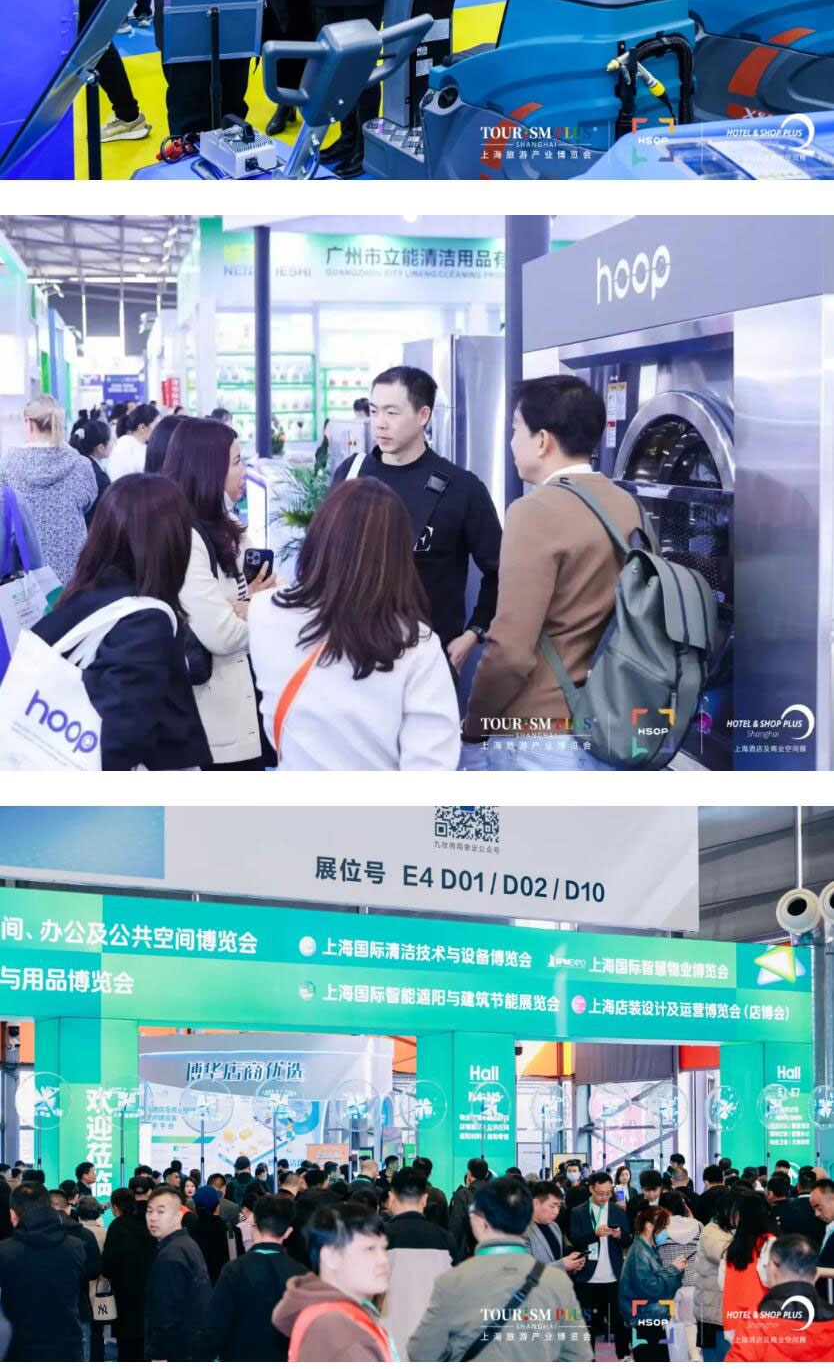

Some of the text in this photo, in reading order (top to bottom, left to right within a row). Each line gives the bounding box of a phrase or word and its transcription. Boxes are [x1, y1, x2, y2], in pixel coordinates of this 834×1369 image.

[325, 246, 505, 269] 广州市立能清洁用品有
[596, 245, 671, 305] hoop
[25, 689, 98, 754] hoop
[315, 855, 606, 903] 展位号 E4 D01 / D02 / D10
[1, 916, 259, 954] 间、办公及公共空间博览会
[322, 937, 532, 969] 上海国际清洁技术与设备博览会
[0, 967, 135, 995] 与用品博览会
[589, 956, 730, 980] 上海国际智慧物业博览会
[322, 983, 561, 1012] 上海国际智能遮阳与建筑节能展览会
[186, 1061, 306, 1082] 博华店商优选
[469, 1065, 499, 1081] Hall
[777, 1065, 801, 1080] Hall
